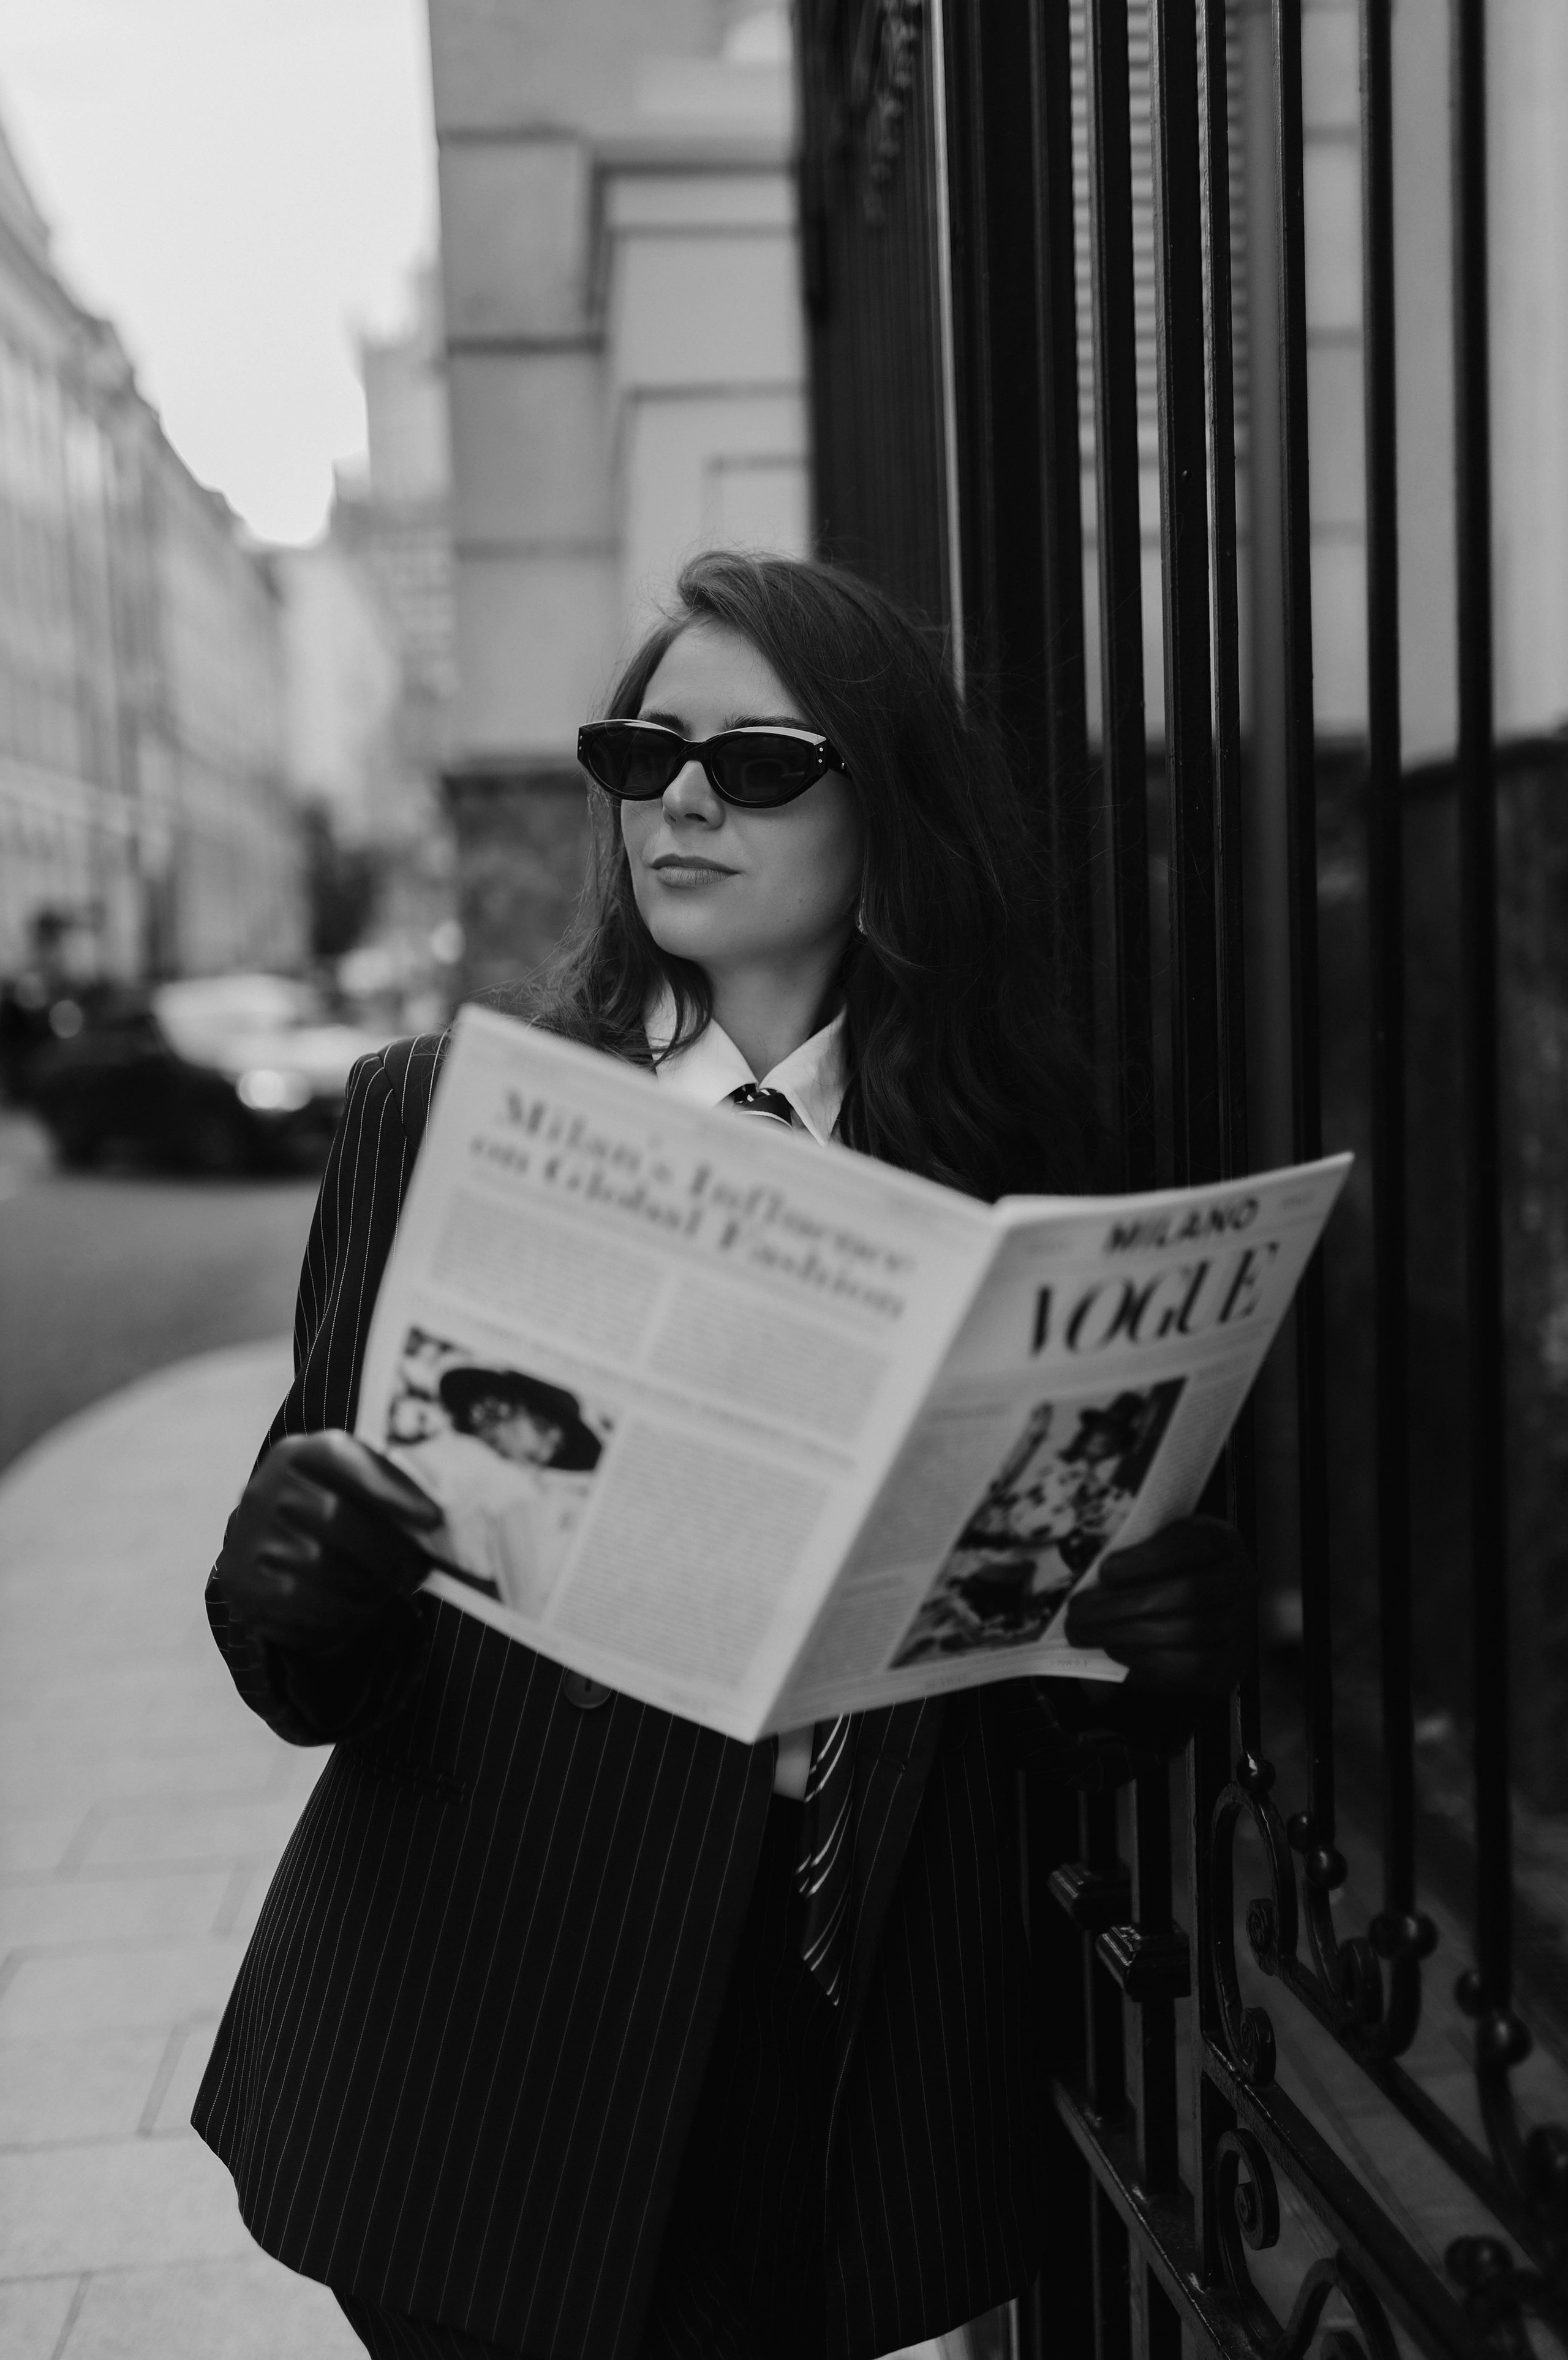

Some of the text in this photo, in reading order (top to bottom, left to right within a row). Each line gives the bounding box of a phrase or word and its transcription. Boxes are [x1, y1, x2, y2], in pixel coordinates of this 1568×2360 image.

[543, 1154, 702, 1239] Global
[718, 1219, 907, 1320] Fashion
[1102, 1195, 1261, 1254] MILANO
[1028, 1241, 1279, 1358] VOGUE
